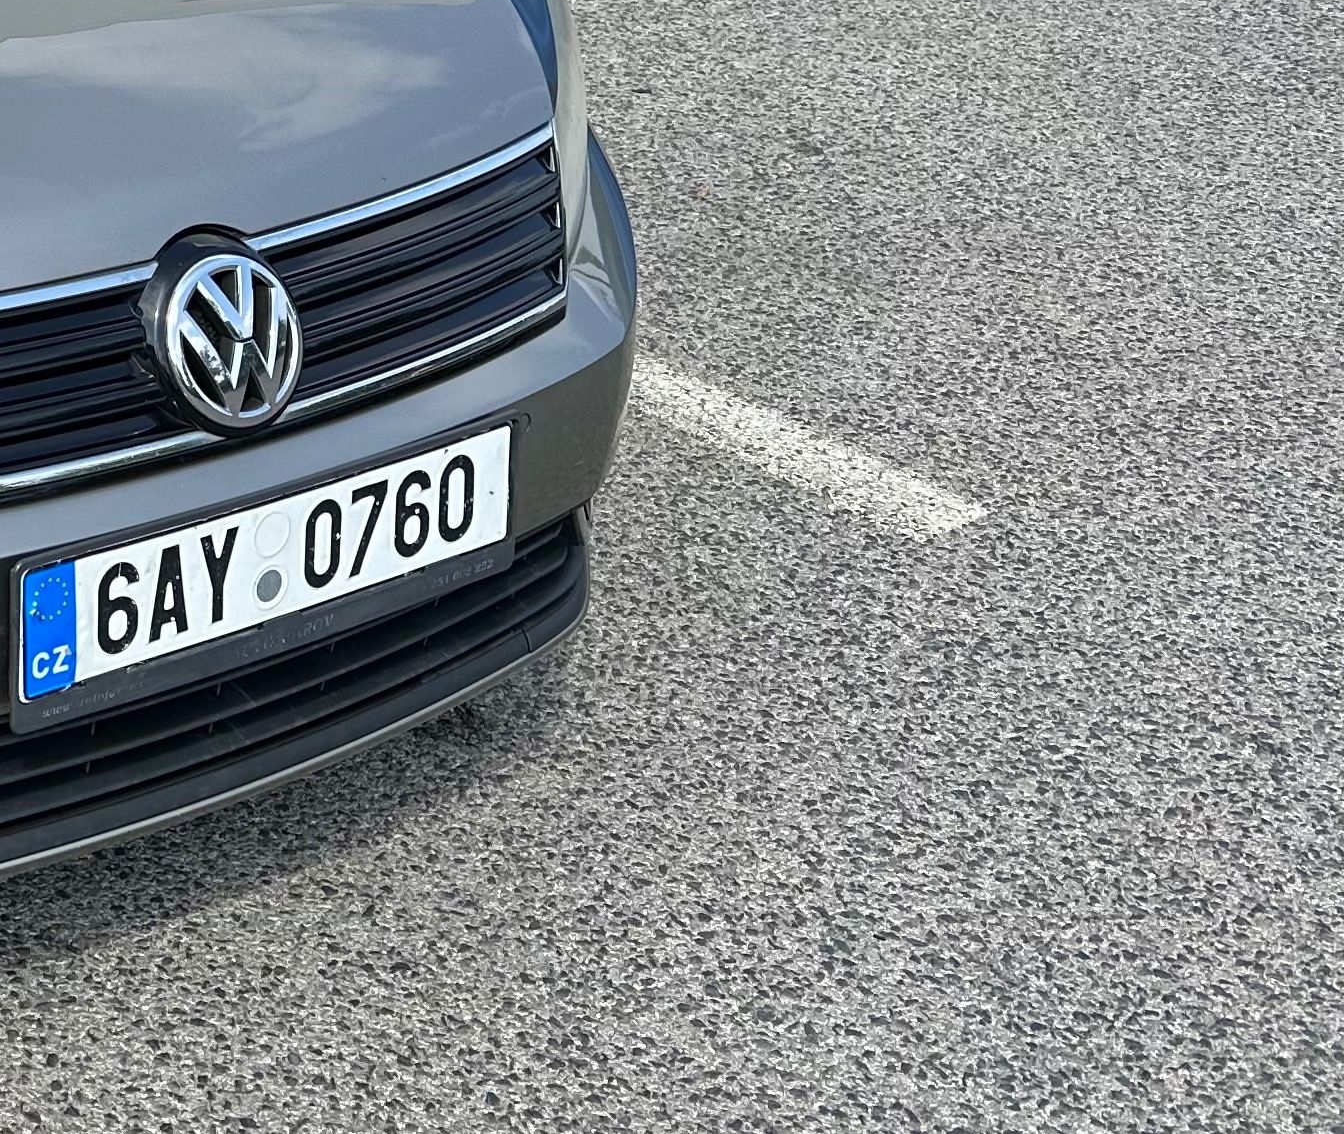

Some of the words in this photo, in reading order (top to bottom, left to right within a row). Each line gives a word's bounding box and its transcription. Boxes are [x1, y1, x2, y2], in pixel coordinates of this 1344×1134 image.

[96, 526, 239, 654] 6AY
[303, 454, 476, 589] 0760
[31, 645, 70, 680] CZ
